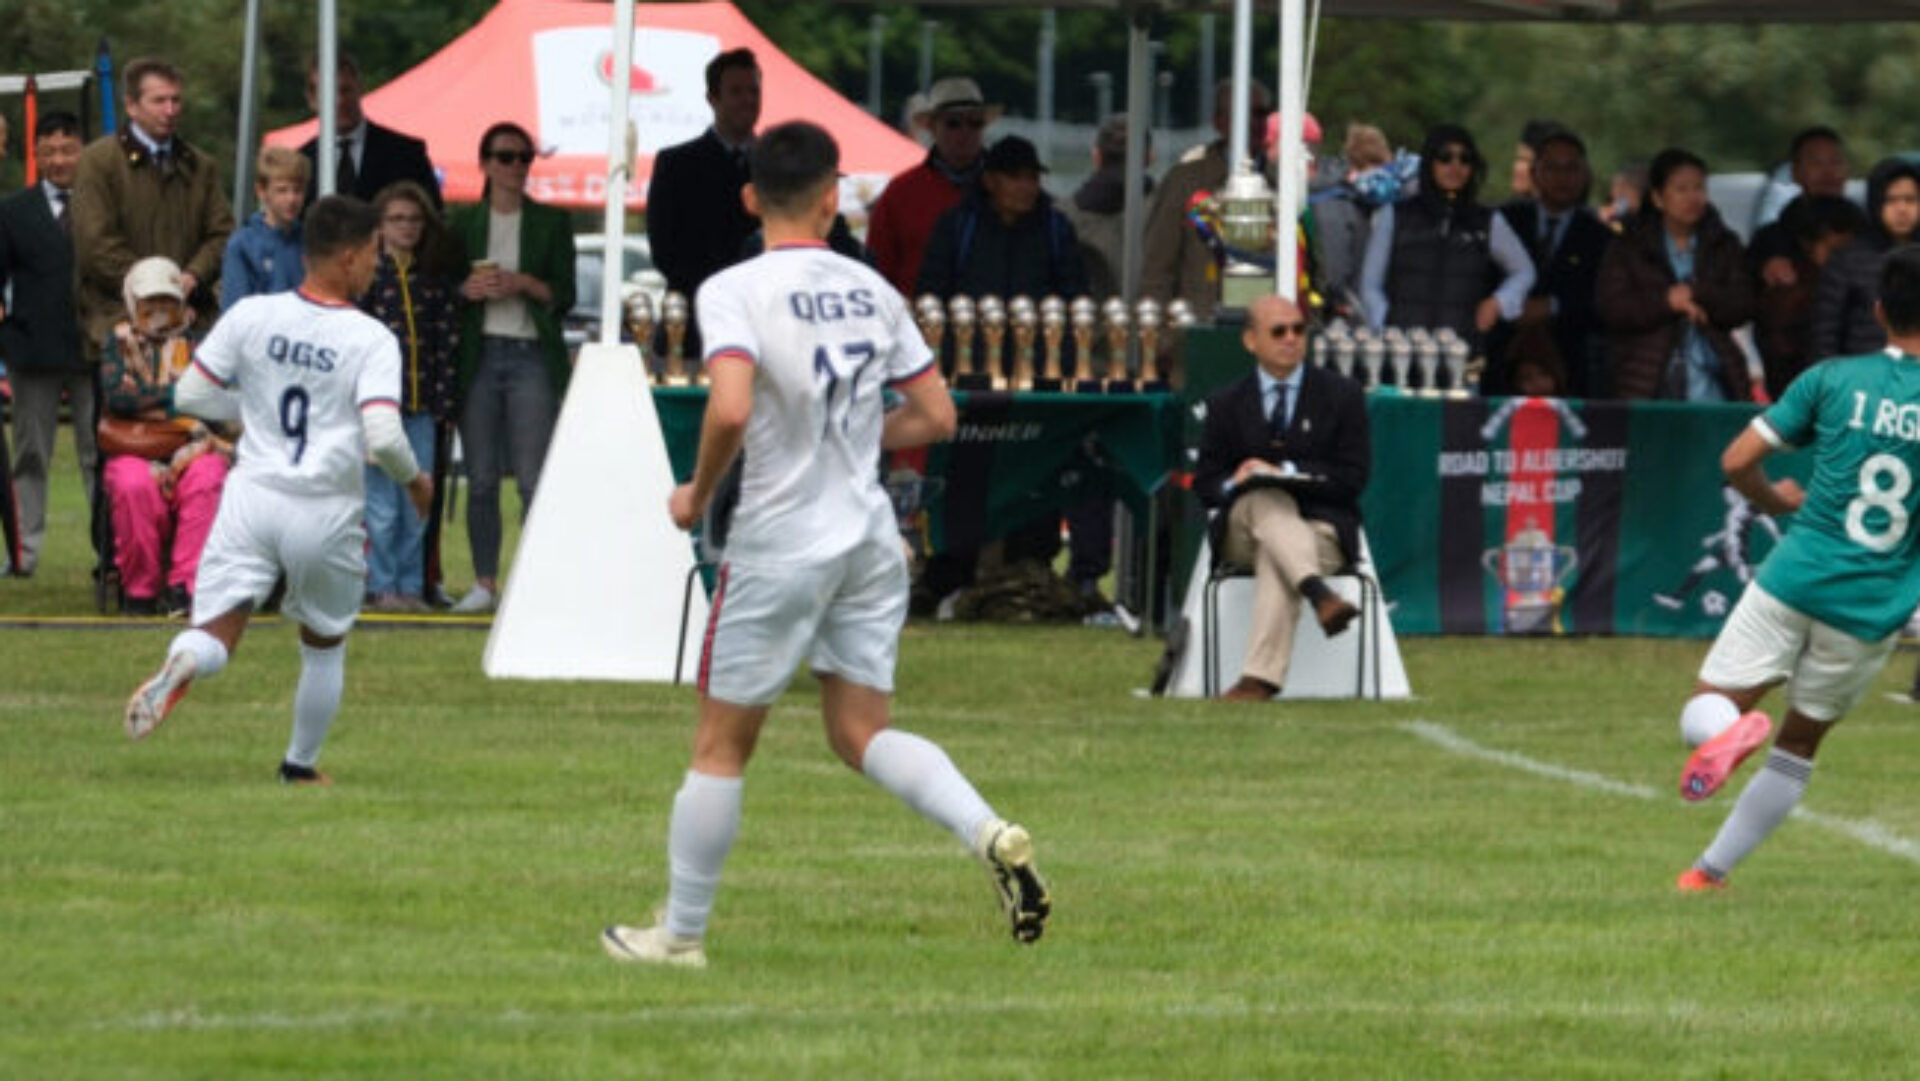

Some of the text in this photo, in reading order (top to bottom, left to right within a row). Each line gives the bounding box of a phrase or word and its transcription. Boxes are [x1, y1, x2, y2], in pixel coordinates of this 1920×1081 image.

[789, 288, 876, 325] QGS
[266, 333, 338, 373] QGS
[812, 339, 876, 441] 17
[280, 384, 310, 466] 9
[1438, 447, 1626, 477] ROAD TO ALDERSHOT
[1480, 477, 1583, 506] NEPAL CUP
[1844, 453, 1913, 553] 8
